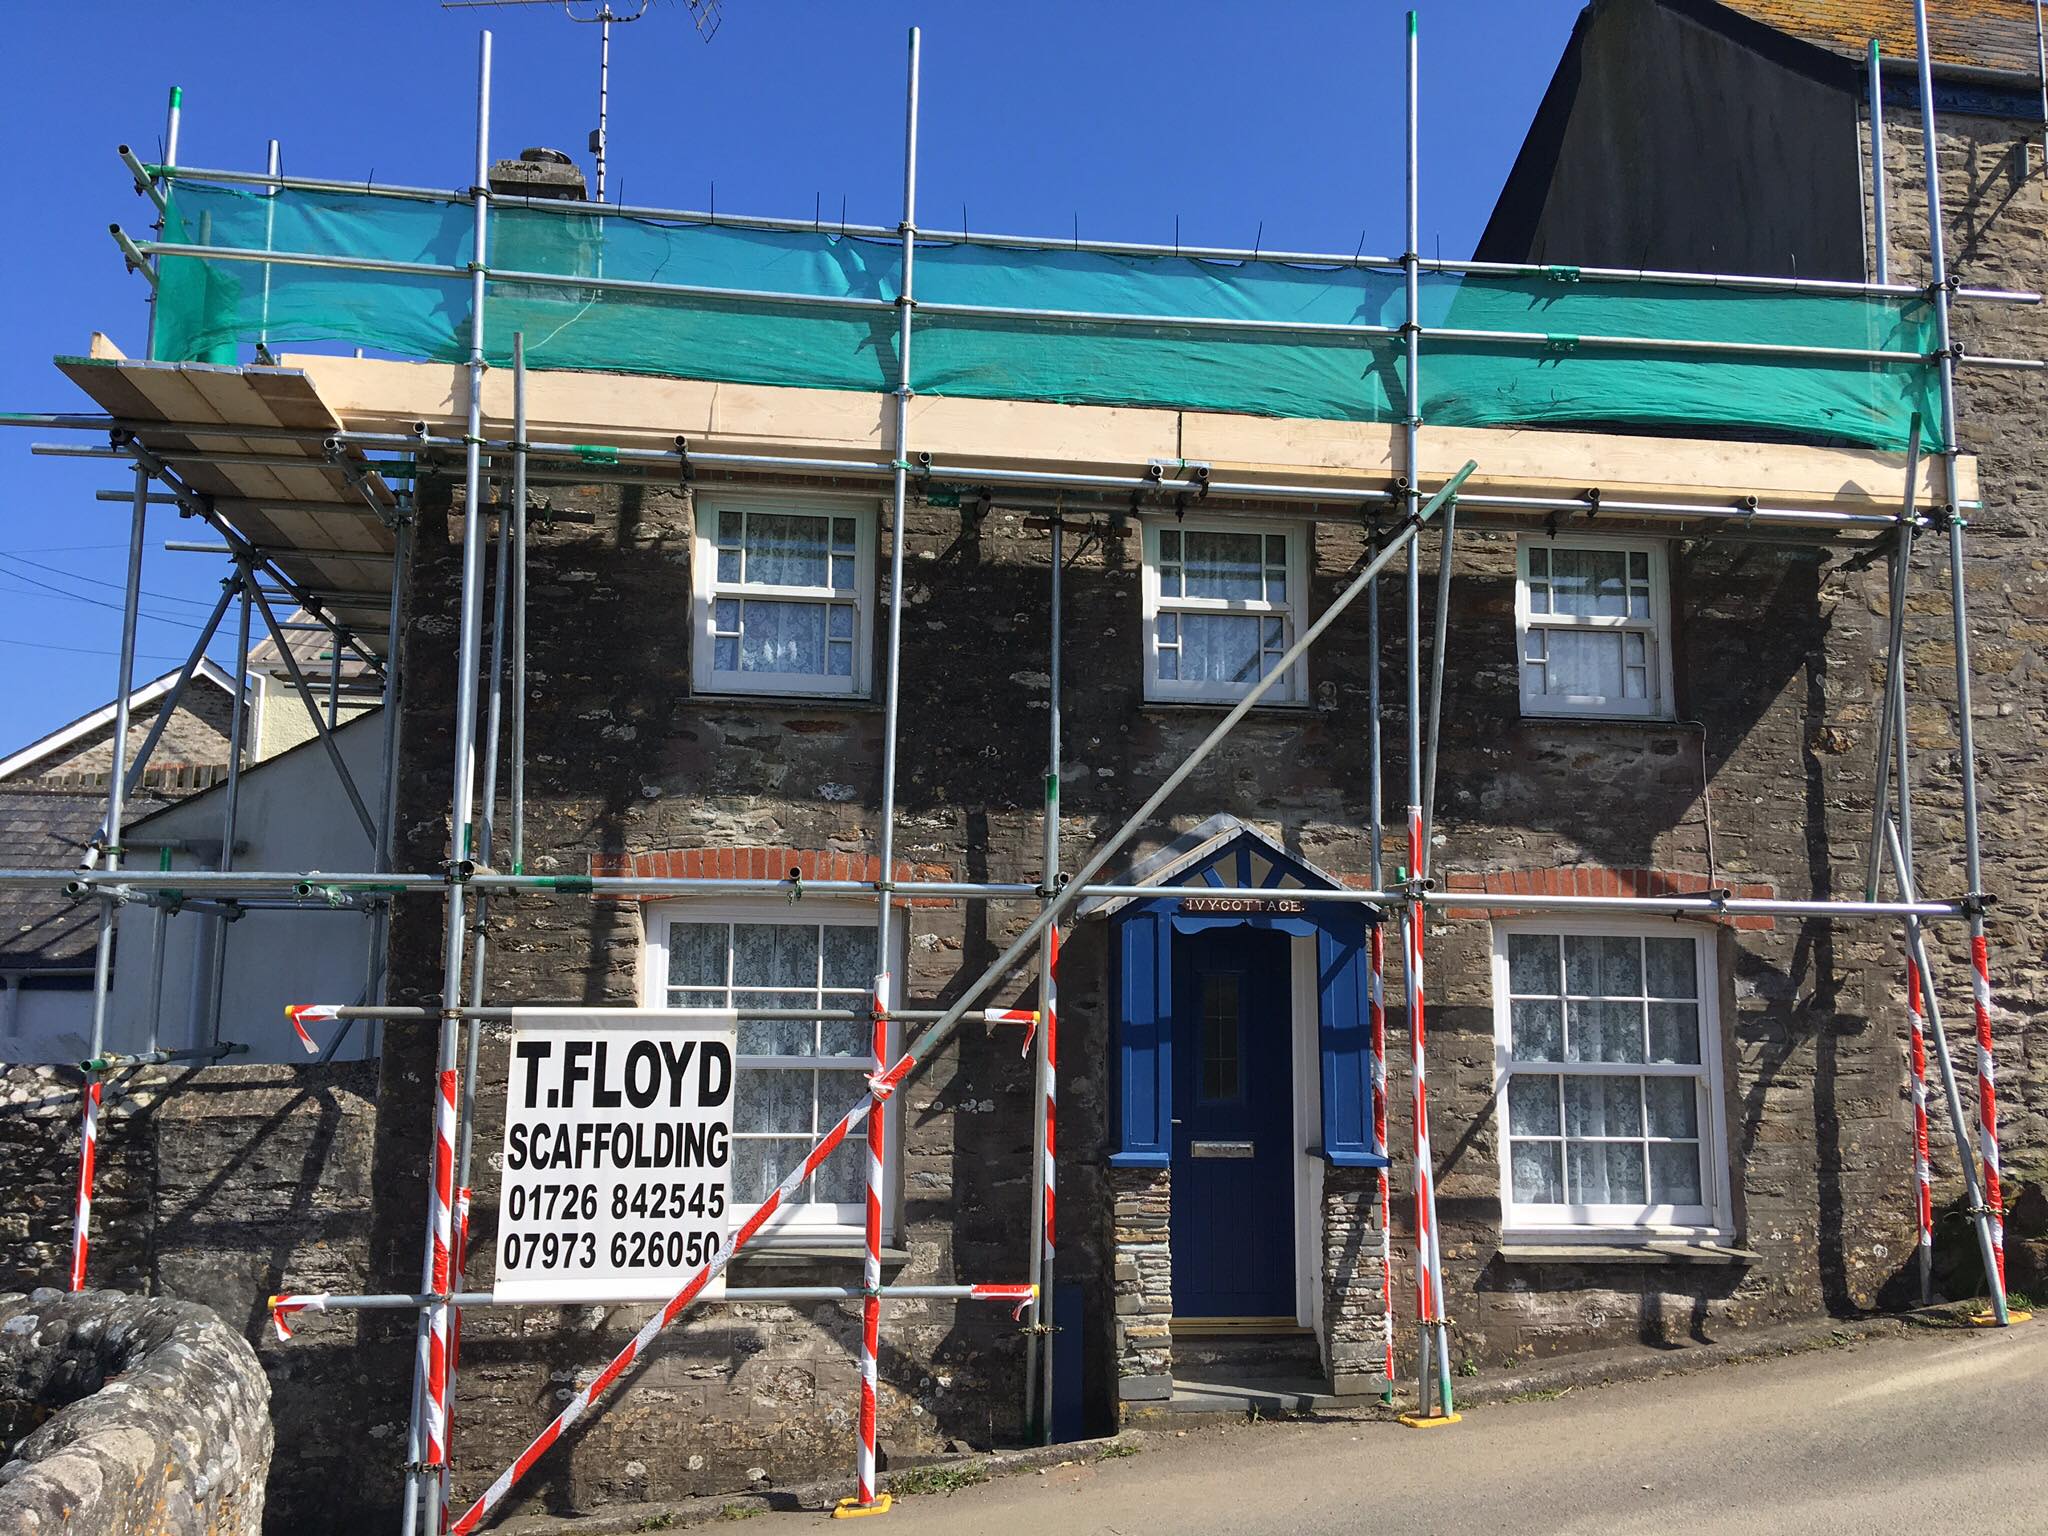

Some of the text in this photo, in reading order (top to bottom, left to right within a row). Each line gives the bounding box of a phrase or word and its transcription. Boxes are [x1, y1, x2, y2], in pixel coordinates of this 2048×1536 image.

[516, 1040, 732, 1108] T.FLOYD
[507, 1122, 729, 1170] SCAFFOLDING
[508, 1183, 725, 1221] 01726 842545
[503, 1231, 720, 1270] 07973 626050
